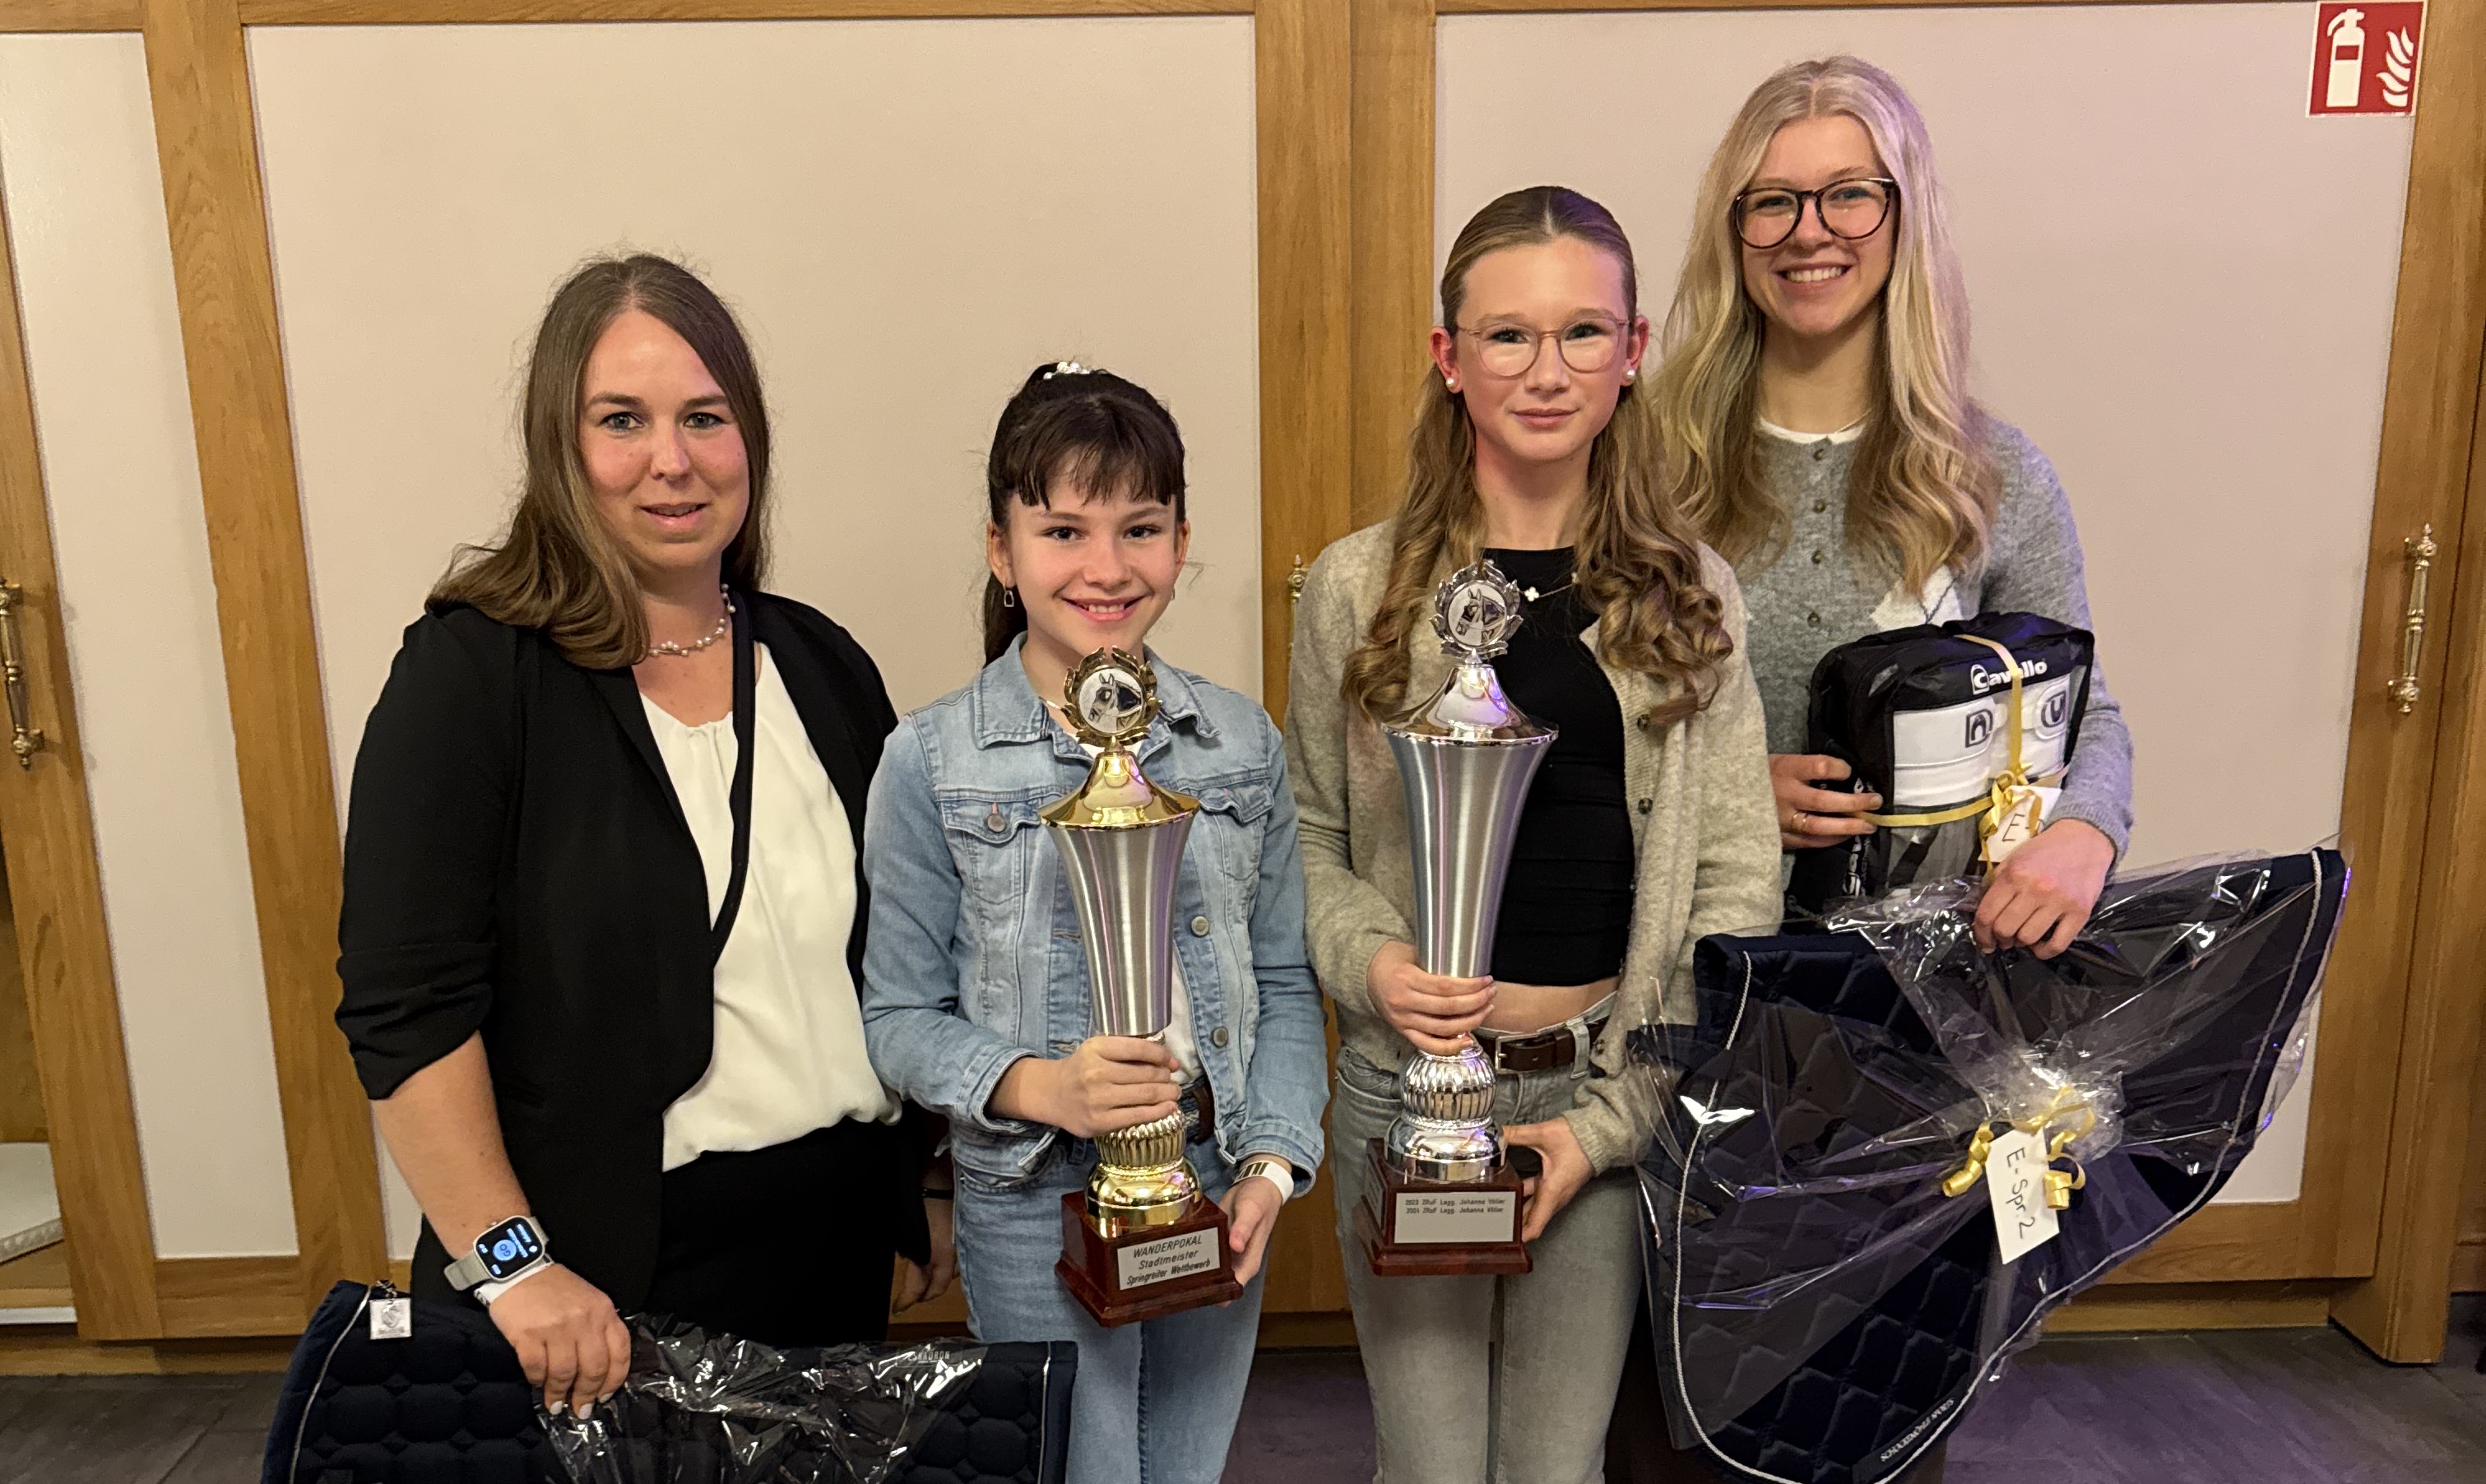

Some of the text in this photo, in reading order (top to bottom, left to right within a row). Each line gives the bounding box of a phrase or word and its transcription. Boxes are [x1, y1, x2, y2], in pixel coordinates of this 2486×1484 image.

[1134, 1235, 1202, 1259] WANDERPOKAL
[1139, 1250, 1199, 1269] Stadtmeister
[907, 1351, 950, 1361] SKADRON
